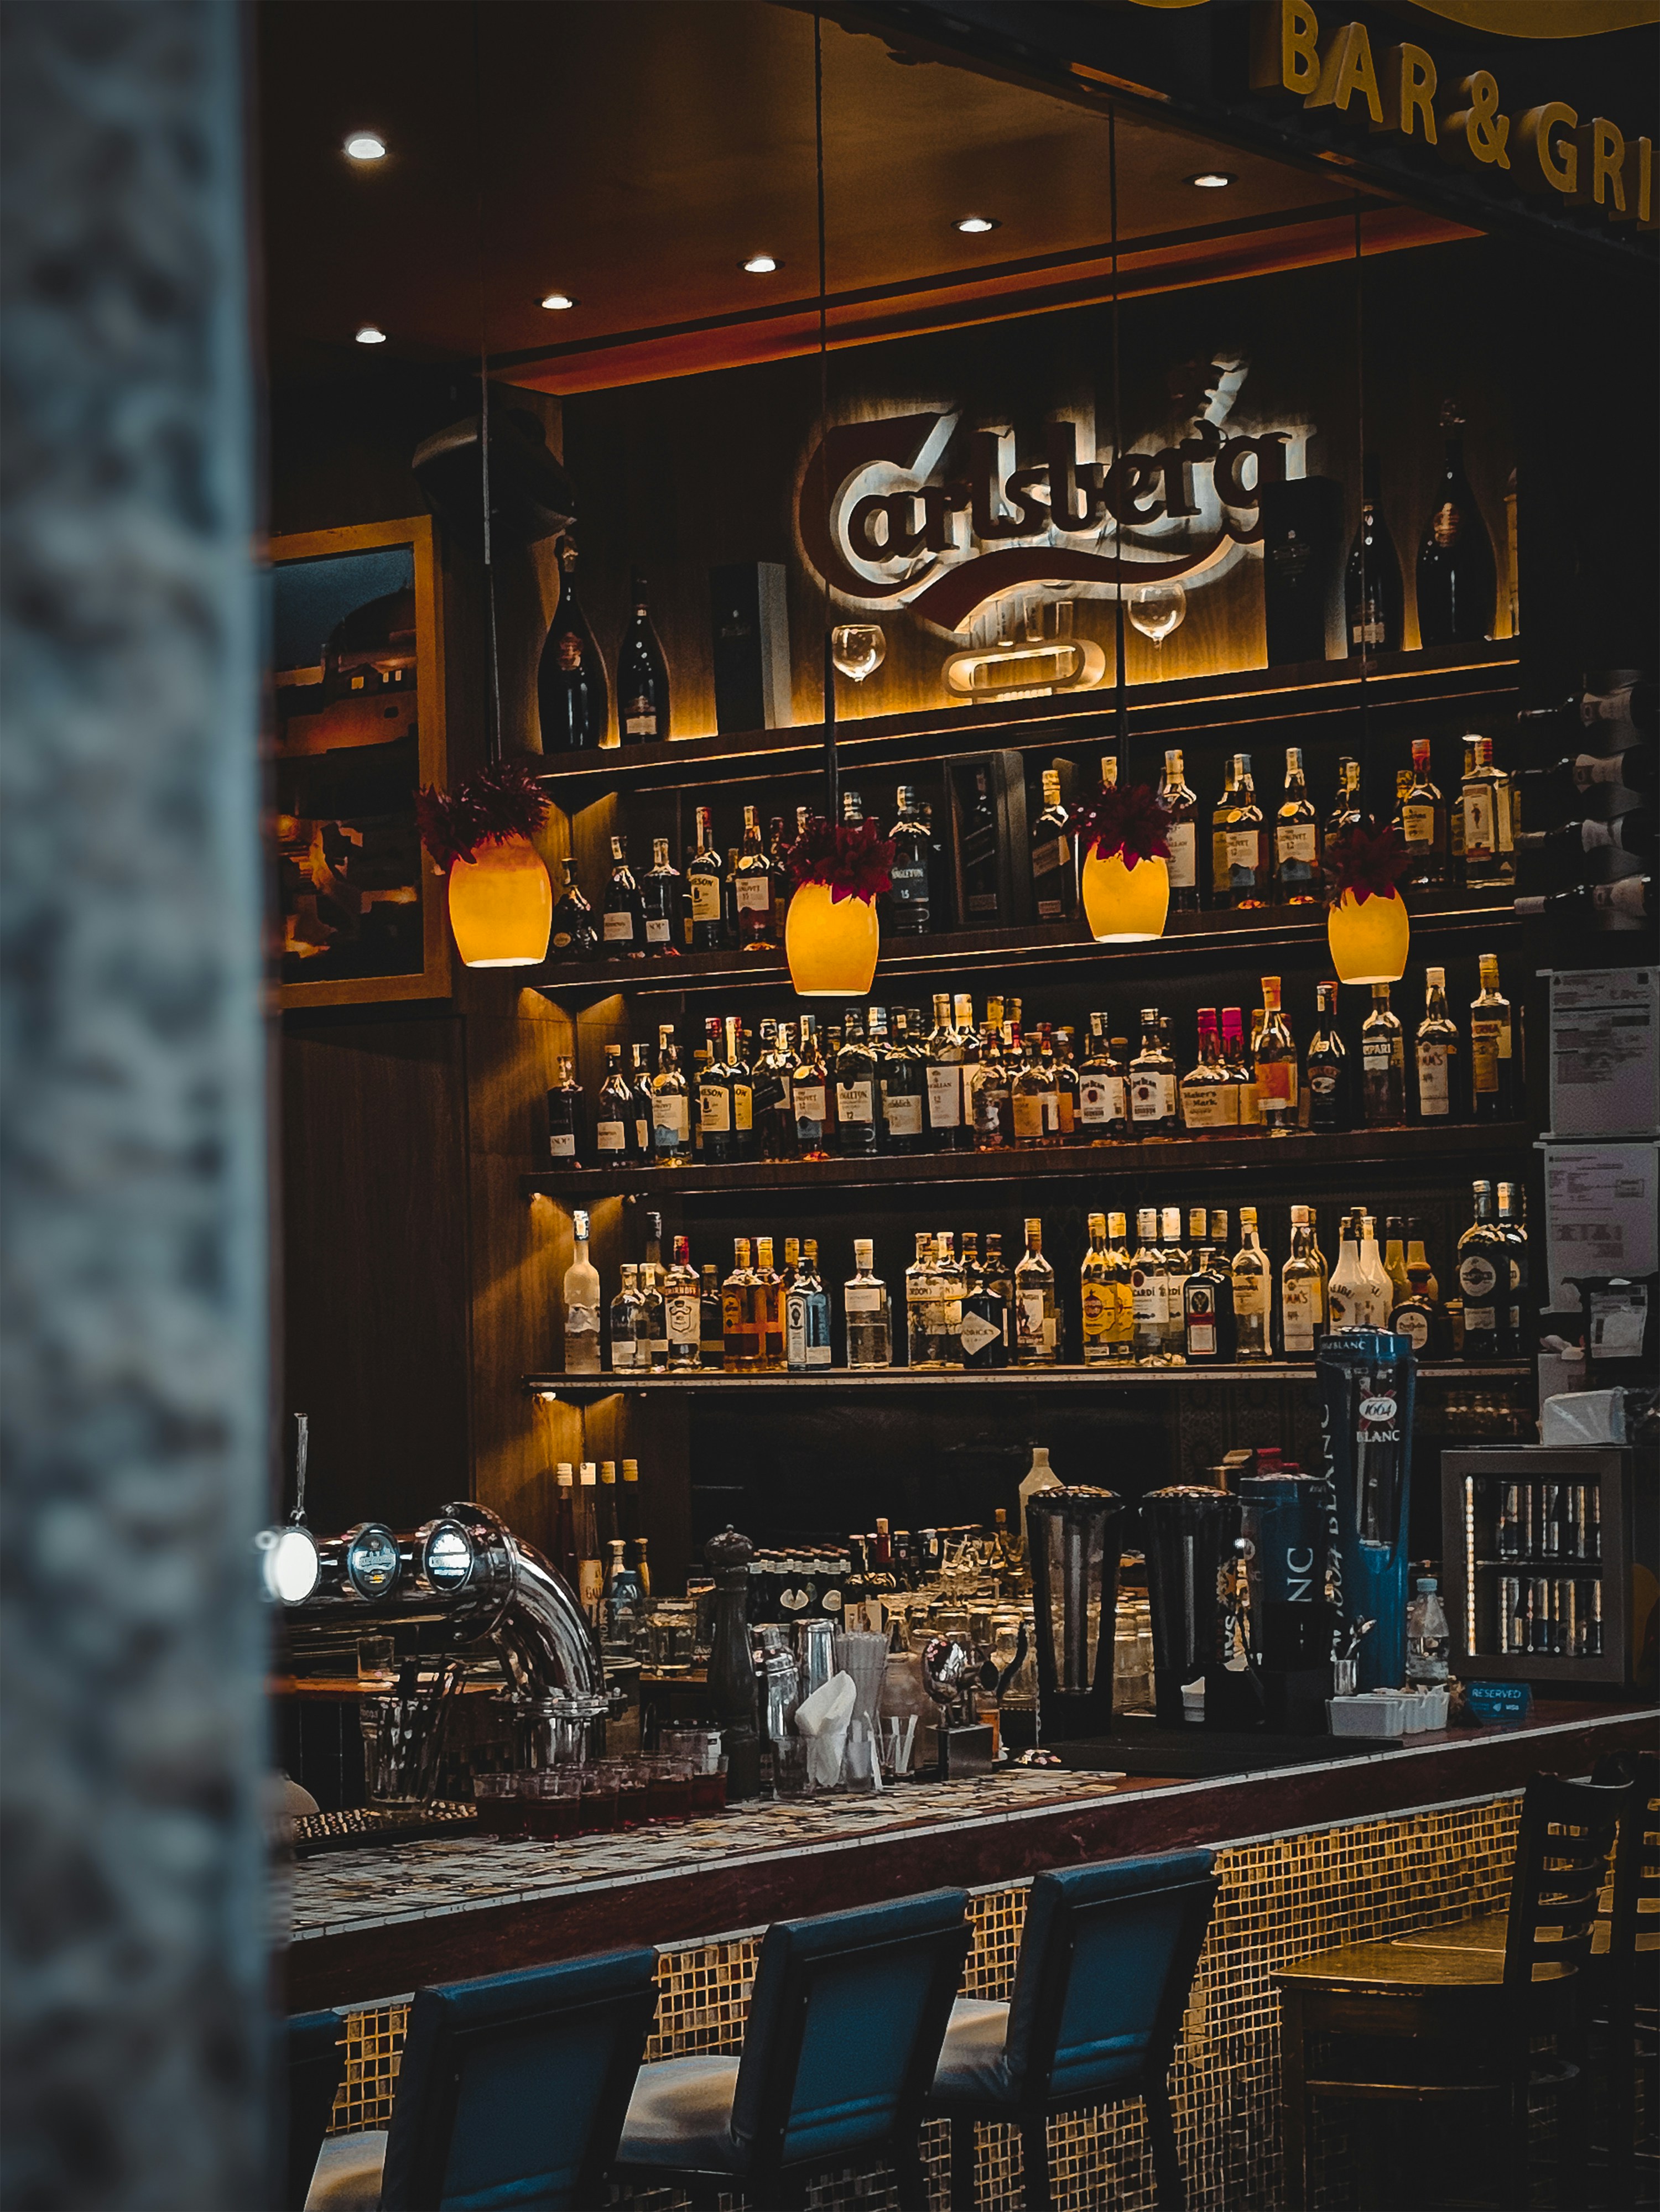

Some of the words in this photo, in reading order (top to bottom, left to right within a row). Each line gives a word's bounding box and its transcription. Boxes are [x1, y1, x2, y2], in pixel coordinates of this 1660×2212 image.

[1282, 0, 1438, 145] BAR
[1465, 70, 1511, 170] &
[799, 409, 1292, 600] Carlsberg
[1334, 1340, 1367, 1350] BLANC
[1365, 1403, 1392, 1417] 1664
[1356, 1430, 1401, 1443] BLANC
[1471, 1688, 1522, 1698] RESERVED
